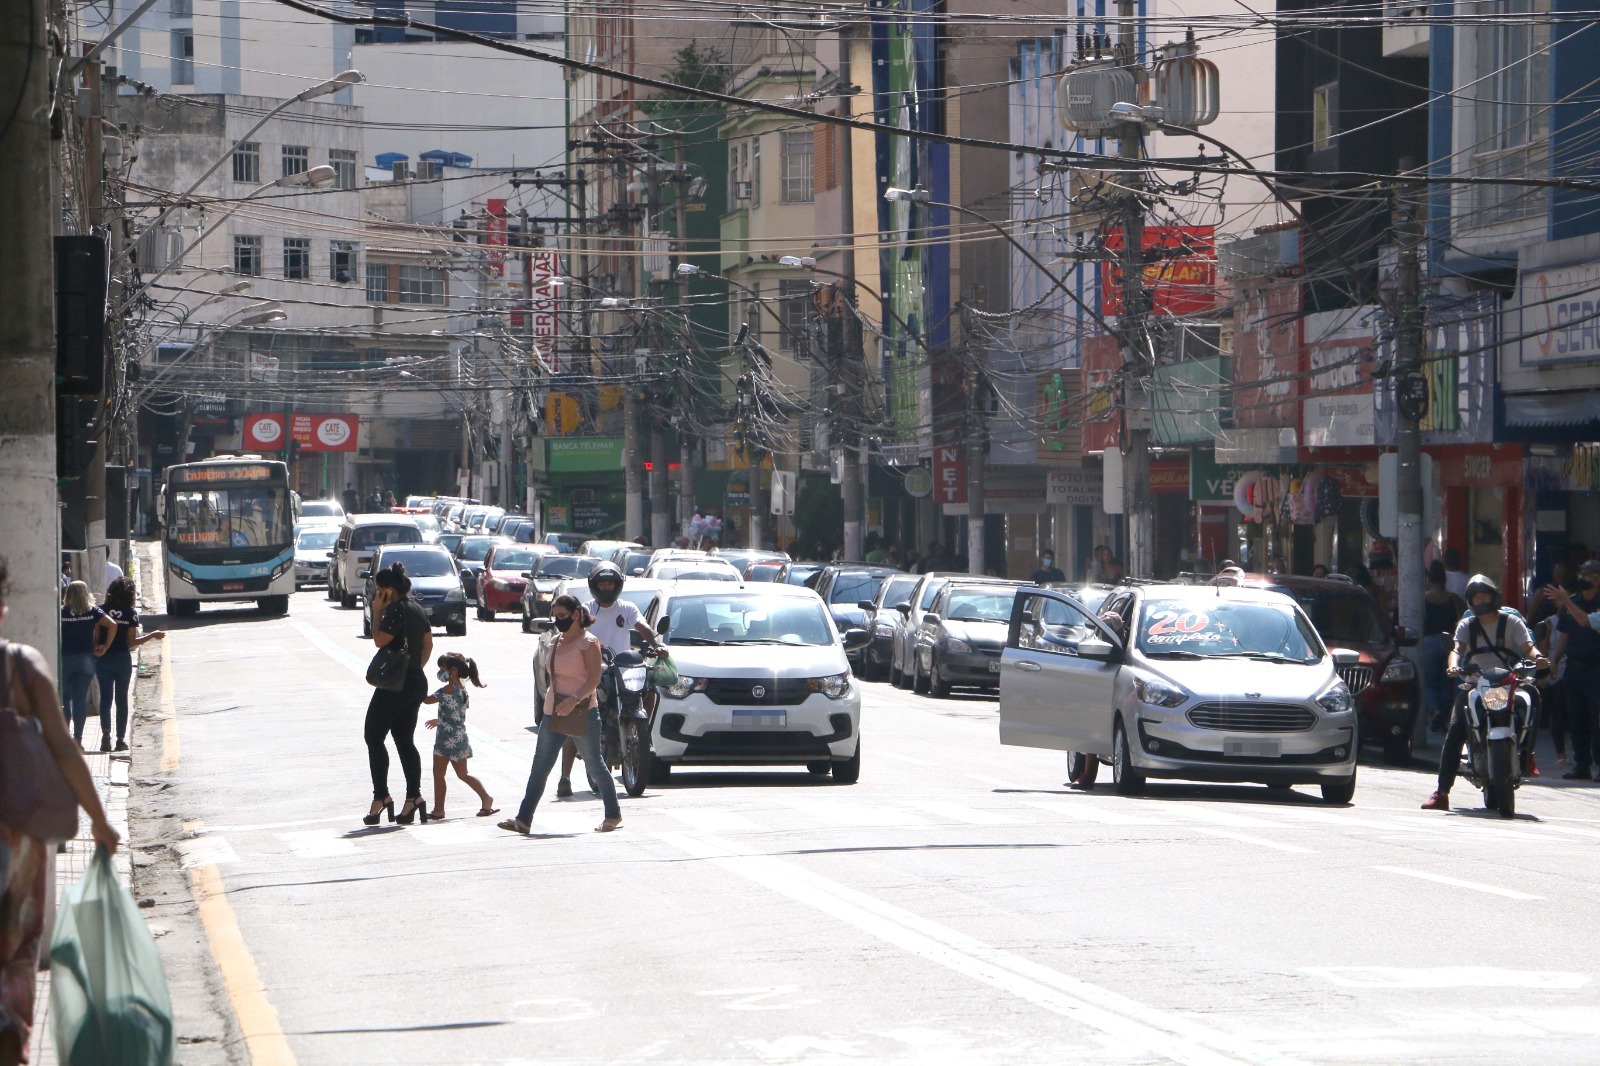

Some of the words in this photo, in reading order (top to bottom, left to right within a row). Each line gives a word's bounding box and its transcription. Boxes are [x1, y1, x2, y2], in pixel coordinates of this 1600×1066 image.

[259, 423, 272, 431] CATE
[325, 423, 340, 432] CATE
[580, 442, 614, 450] TELEMAR
[1051, 473, 1082, 482] FOTO
[1052, 485, 1102, 493] TOTALME
[1206, 479, 1233, 495] VE
[250, 567, 268, 575] 242
[1148, 610, 1209, 635] 20
